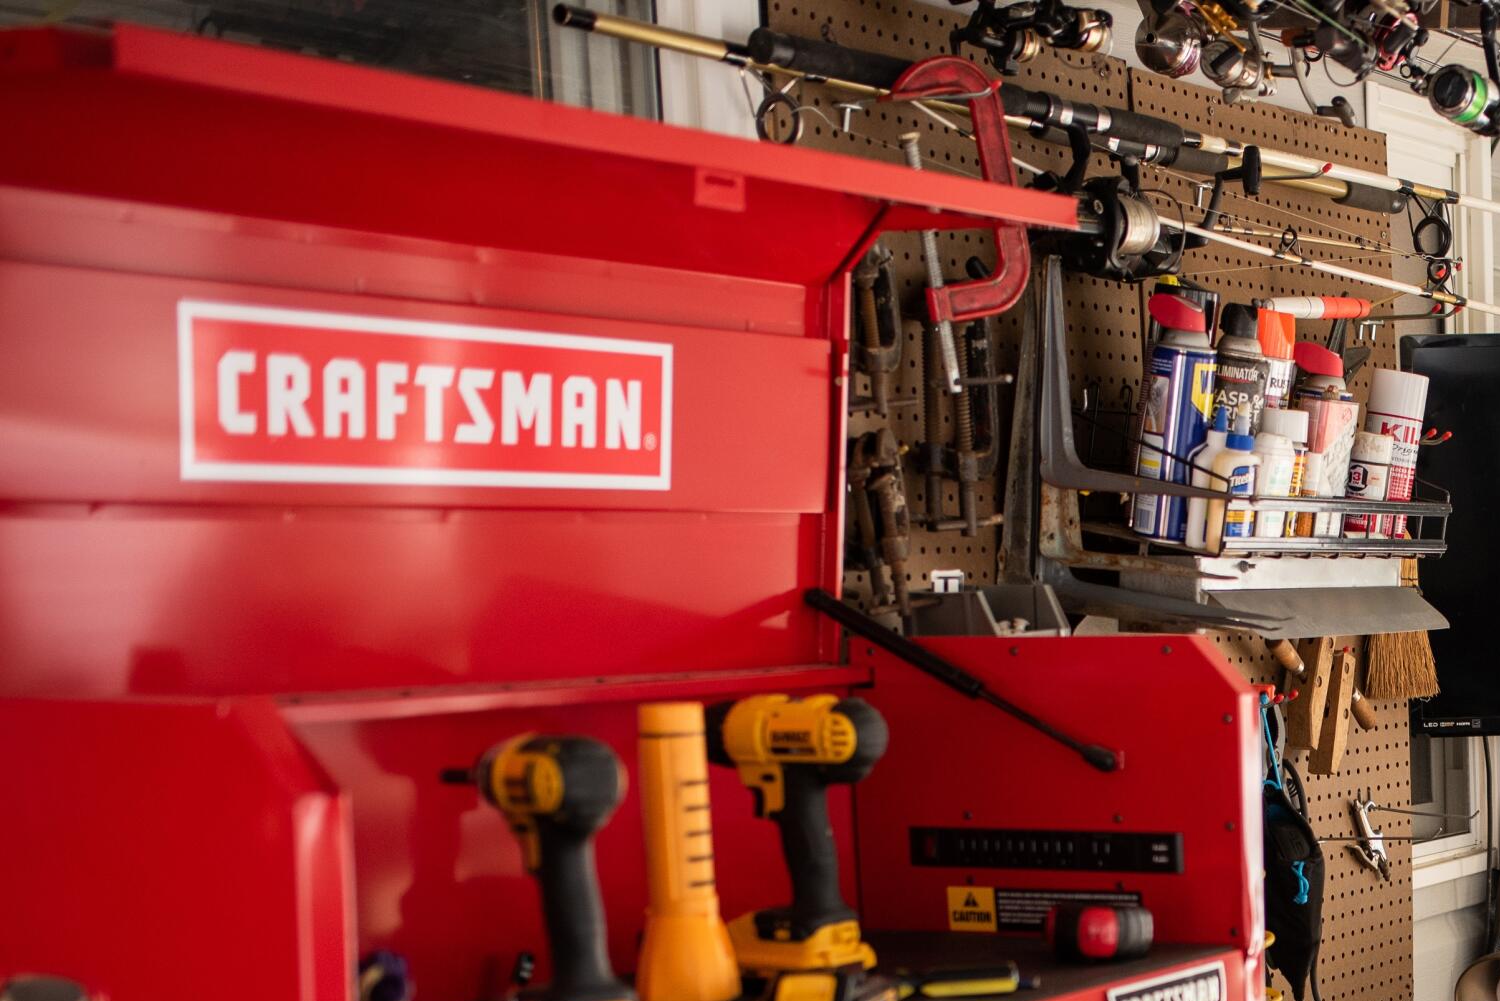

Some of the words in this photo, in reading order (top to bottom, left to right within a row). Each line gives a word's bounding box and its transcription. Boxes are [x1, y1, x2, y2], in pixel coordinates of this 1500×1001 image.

[217, 349, 642, 450] CRAFTSMAN
[1214, 389, 1248, 406] ASP
[952, 910, 992, 924] CAUTION
